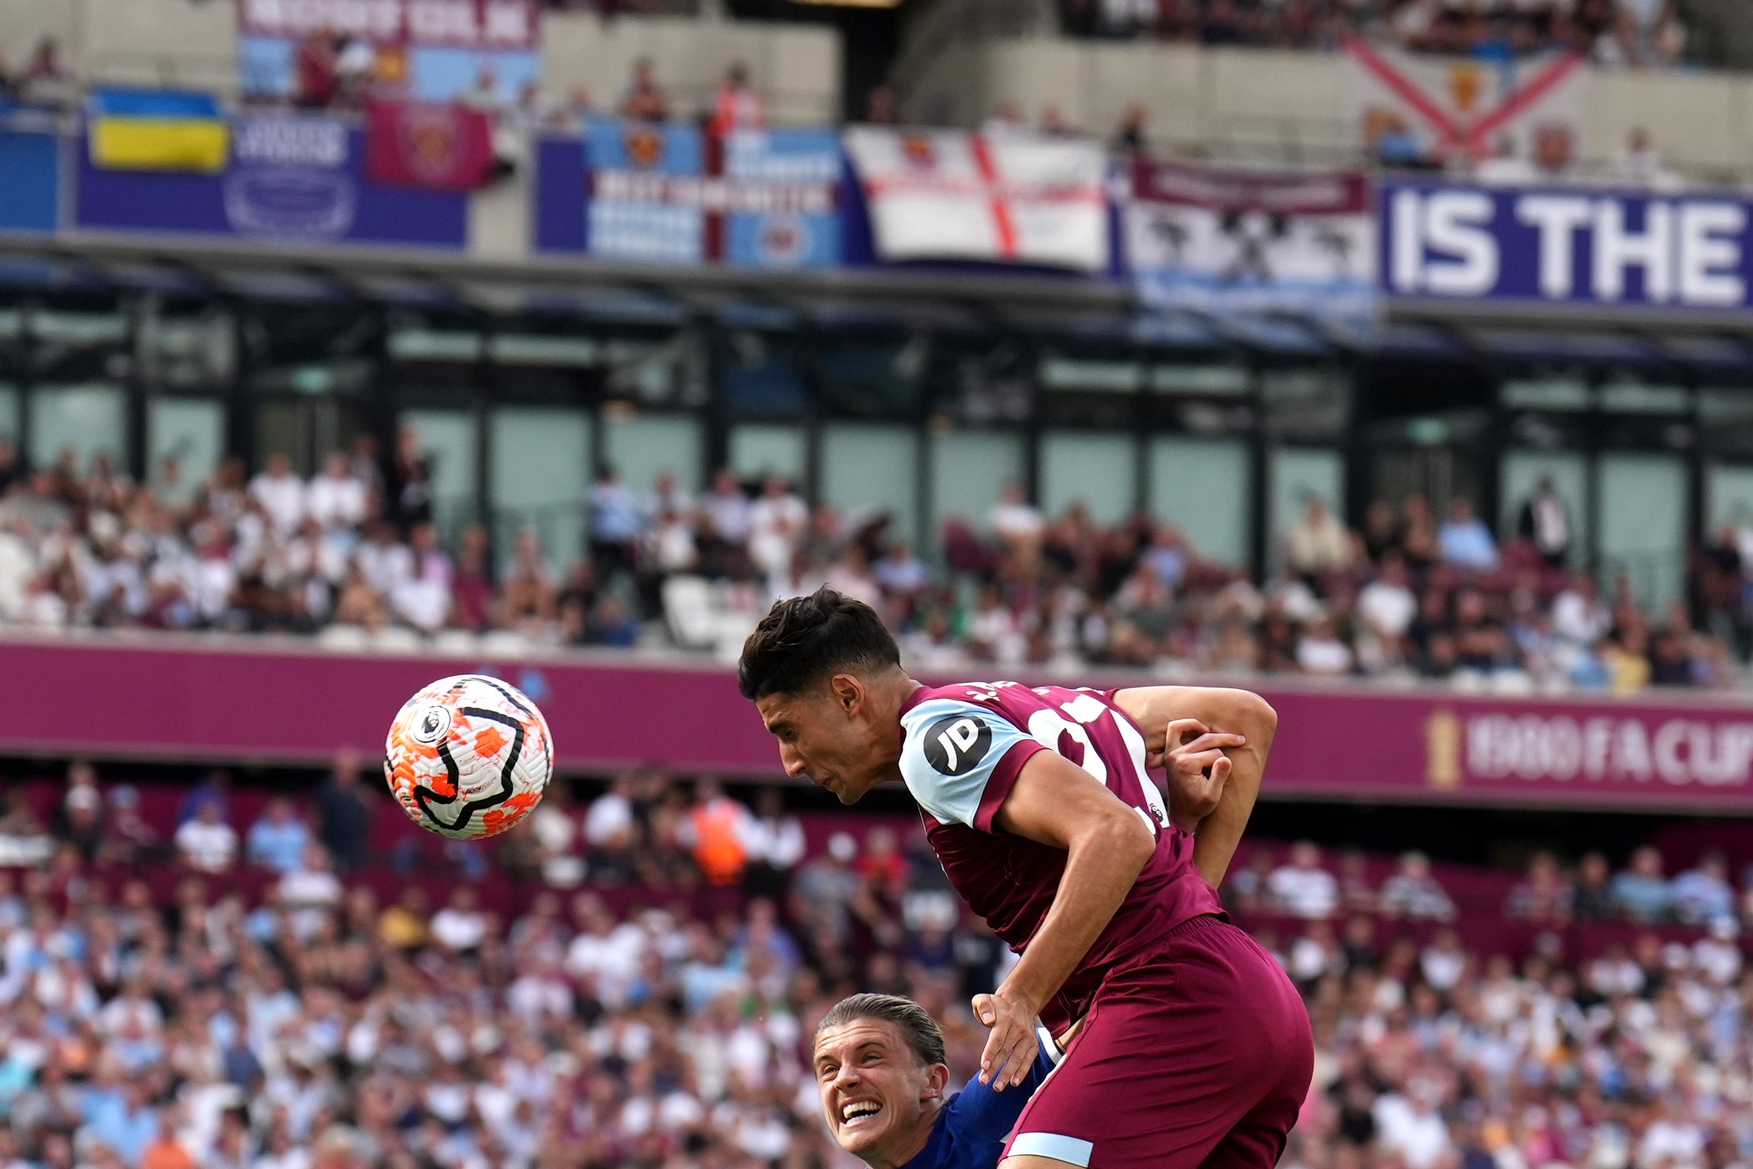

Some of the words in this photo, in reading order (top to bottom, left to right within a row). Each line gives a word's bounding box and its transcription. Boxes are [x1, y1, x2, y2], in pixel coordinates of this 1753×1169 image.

[1391, 190, 1499, 296] IS
[1515, 197, 1746, 306] THE
[937, 718, 979, 772] JD
